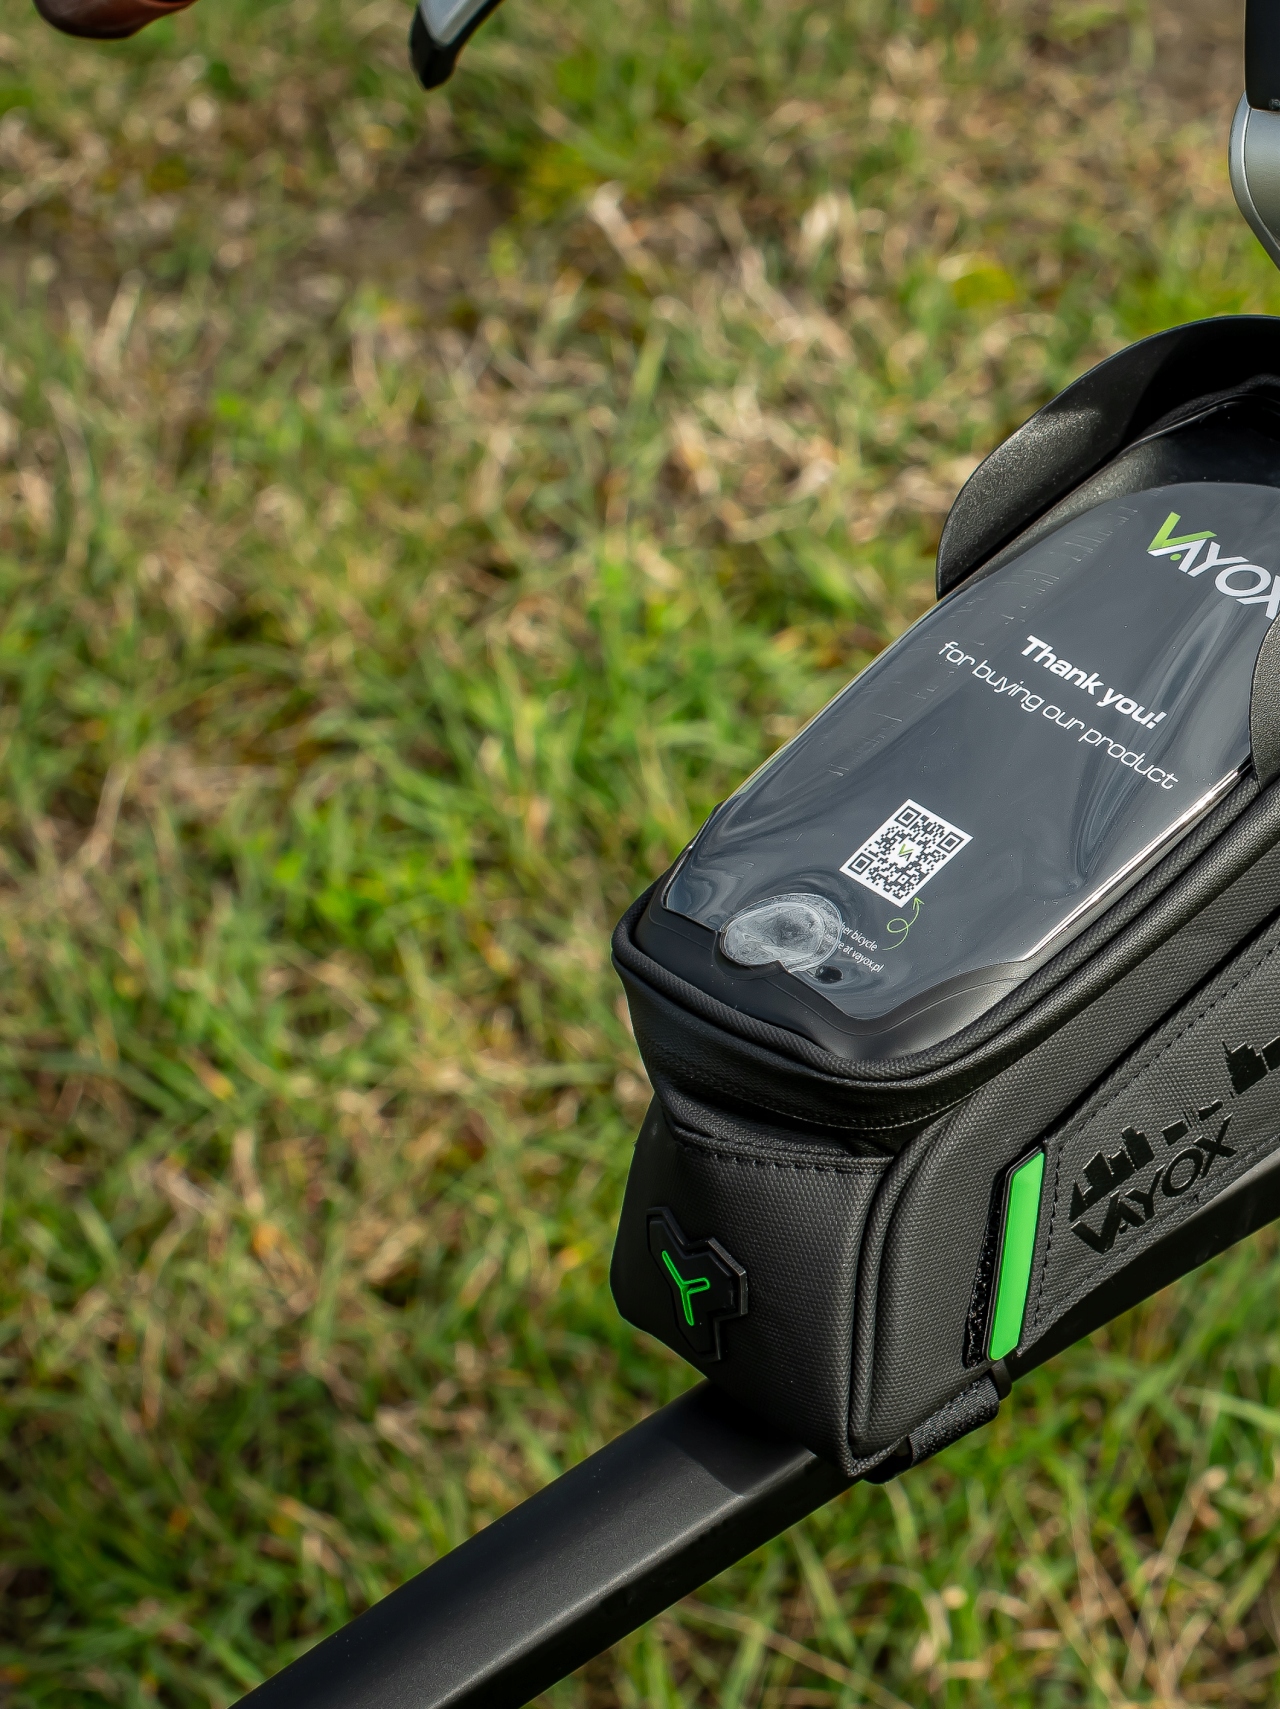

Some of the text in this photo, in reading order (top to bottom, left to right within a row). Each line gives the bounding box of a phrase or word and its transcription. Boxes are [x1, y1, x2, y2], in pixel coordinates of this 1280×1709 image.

[938, 641, 1179, 790] for buying our product
[1021, 634, 1168, 730] Thank you!
[842, 945, 885, 973] at vayox.pl
[850, 929, 878, 952] bicycle
[1070, 1113, 1238, 1255] VAYOX
